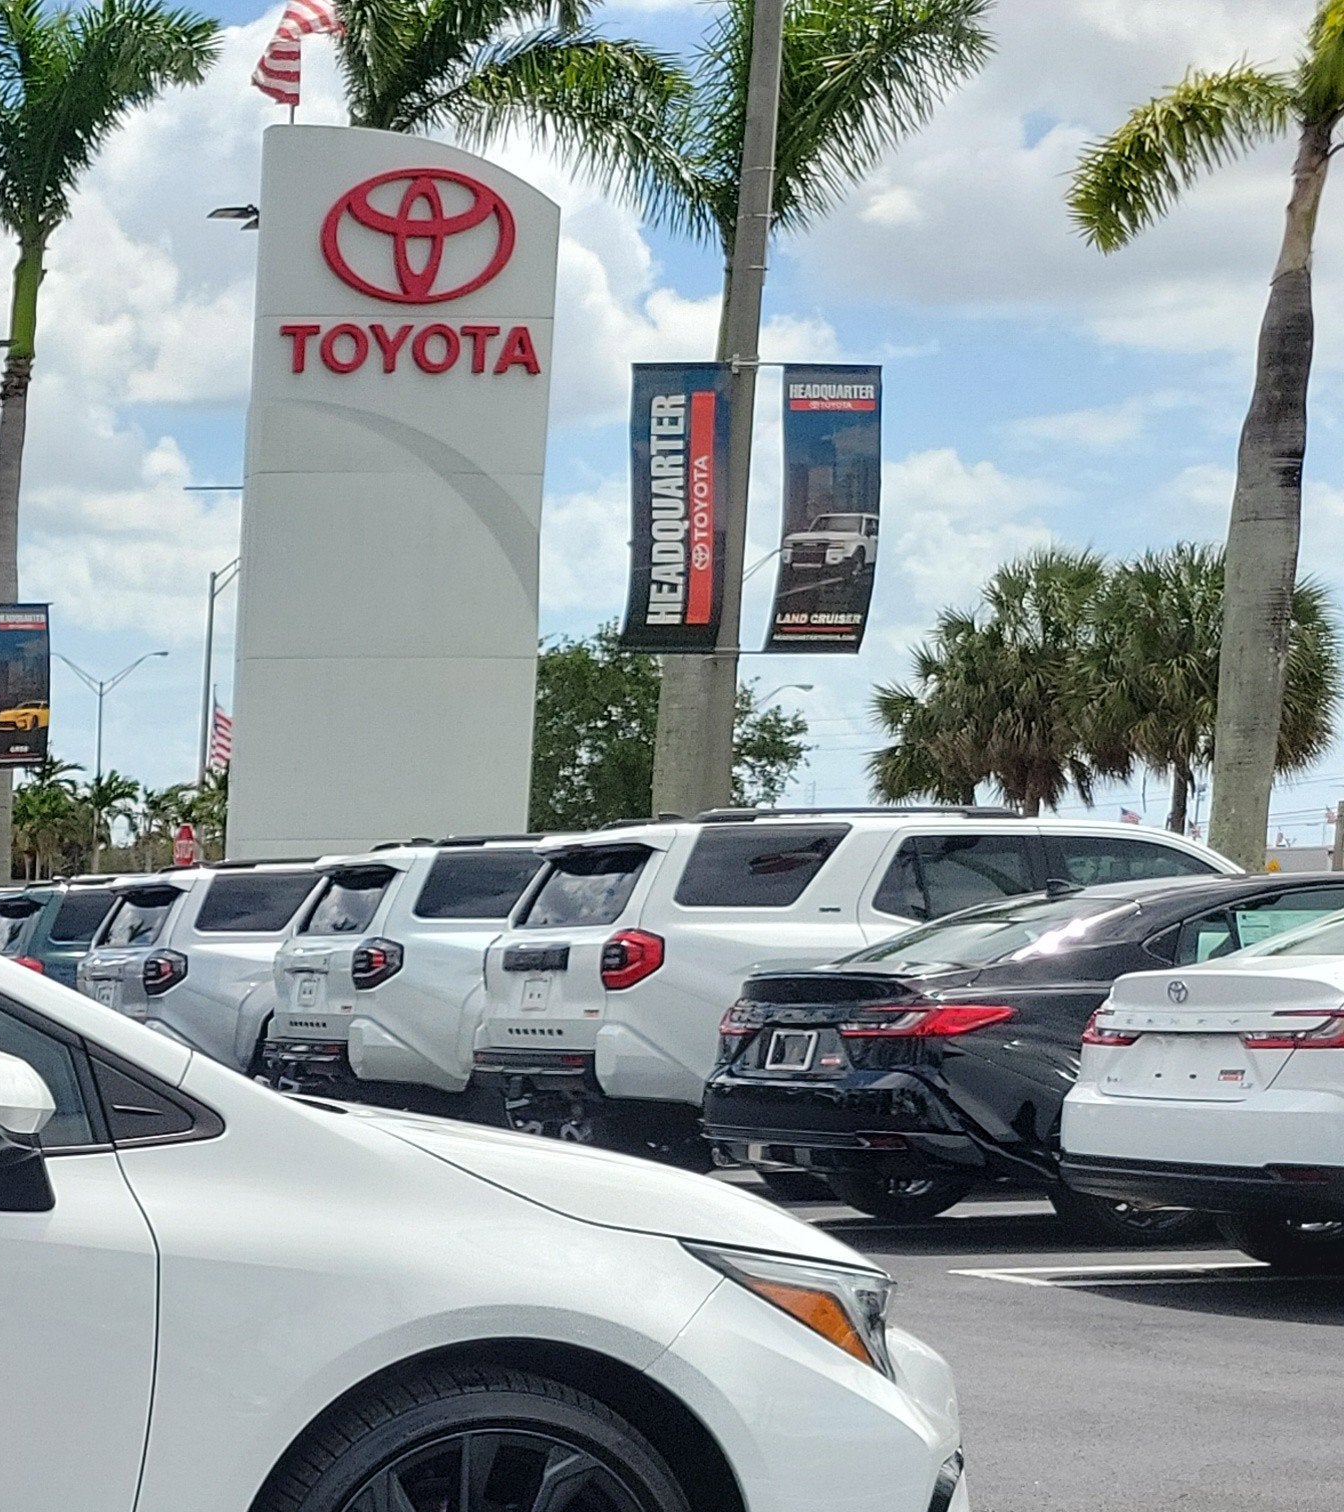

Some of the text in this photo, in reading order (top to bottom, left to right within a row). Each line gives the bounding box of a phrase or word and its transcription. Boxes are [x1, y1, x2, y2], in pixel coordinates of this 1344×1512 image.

[280, 323, 541, 375] TOYOTA
[789, 384, 874, 400] HEADQUARTER
[646, 394, 690, 625] HEADQUARTER
[692, 454, 711, 541] TOYOTA
[775, 613, 862, 624] LAND CRUISER
